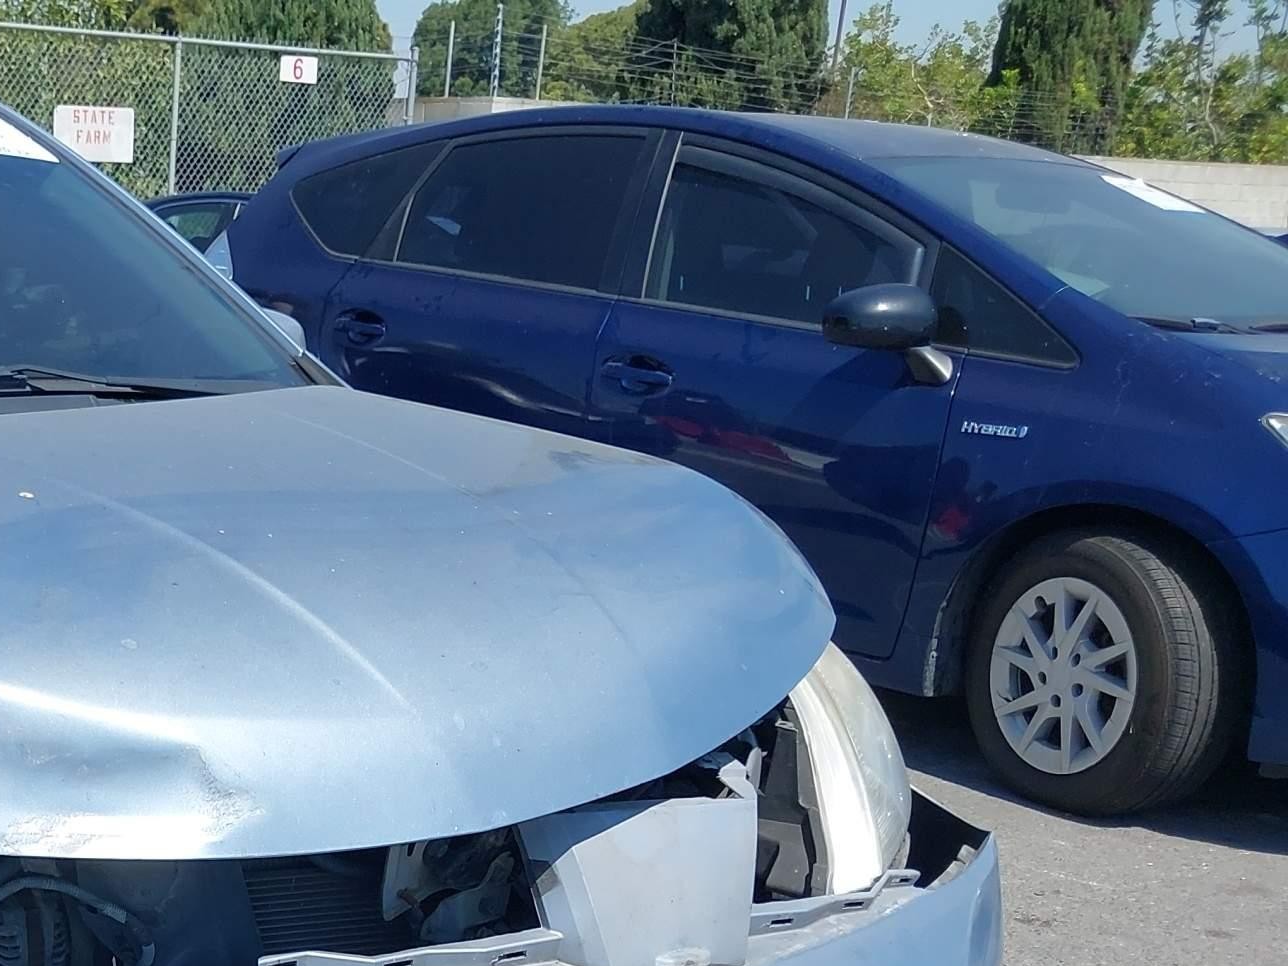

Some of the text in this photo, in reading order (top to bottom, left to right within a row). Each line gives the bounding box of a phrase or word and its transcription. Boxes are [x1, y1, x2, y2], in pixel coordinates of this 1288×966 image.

[293, 58, 304, 80] 6
[72, 109, 116, 125] STATE
[75, 130, 112, 145] FARM
[960, 421, 1017, 438] HYBRID
